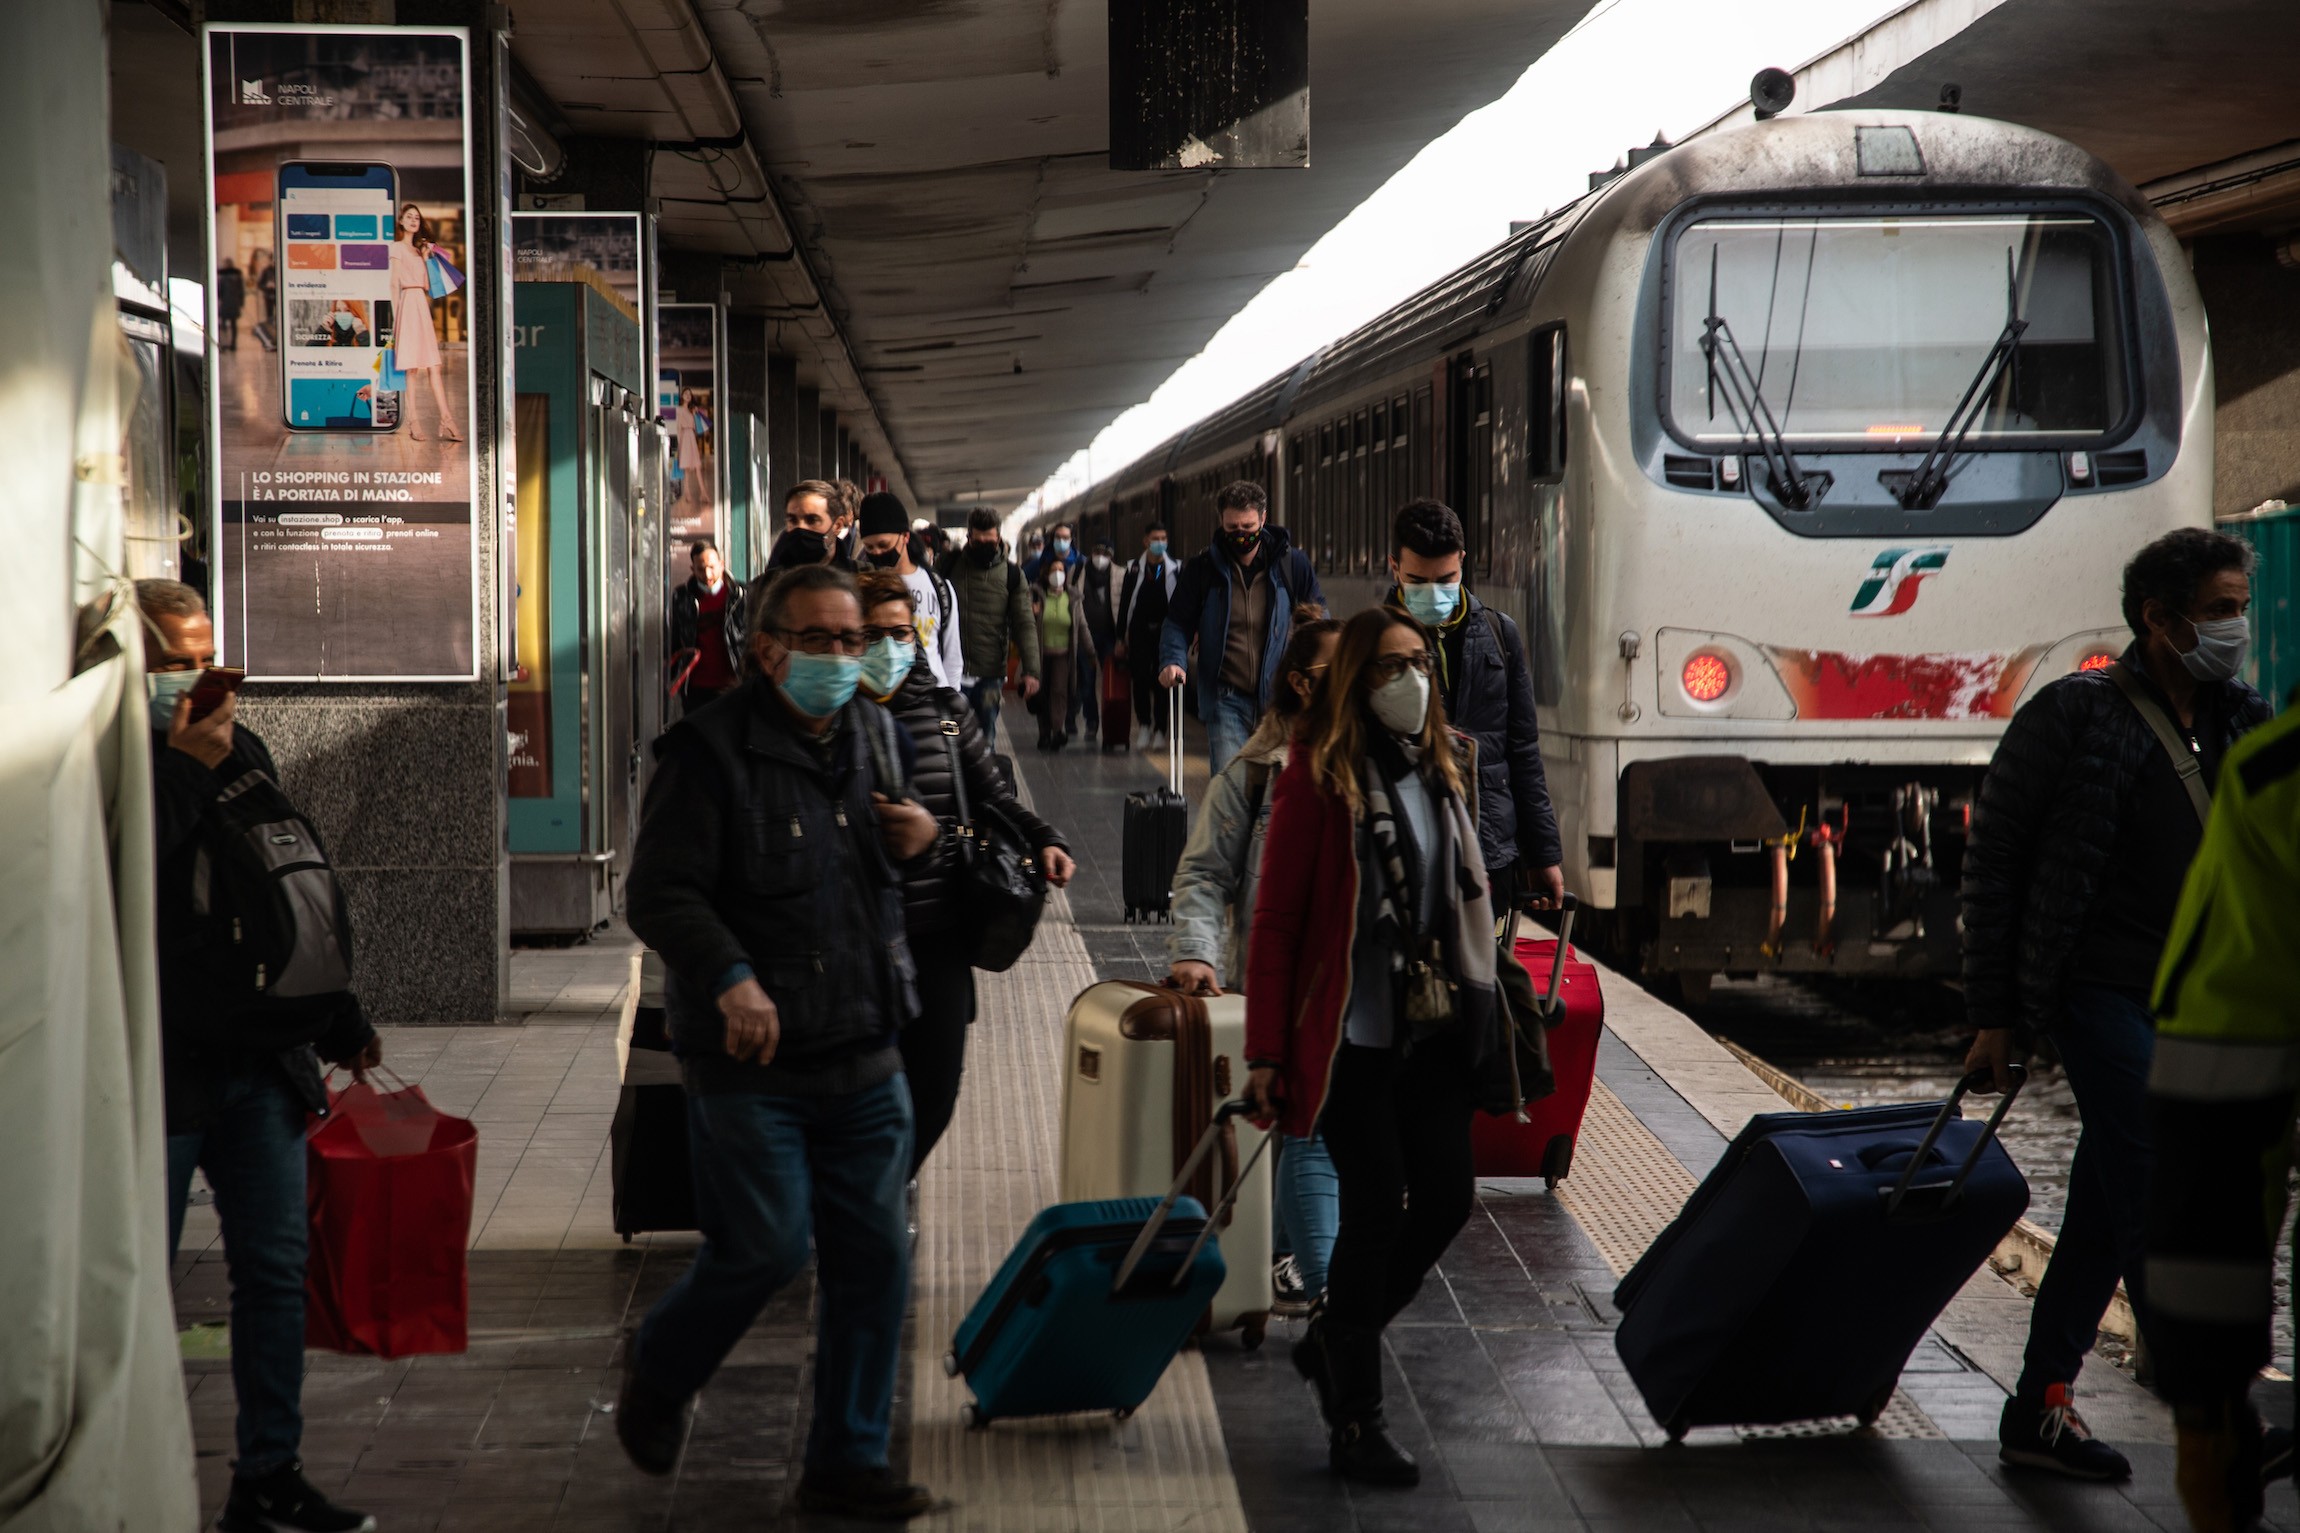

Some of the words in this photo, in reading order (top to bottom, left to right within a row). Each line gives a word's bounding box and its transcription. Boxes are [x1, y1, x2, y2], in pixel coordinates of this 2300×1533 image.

[277, 84, 317, 94] NAPOLI
[277, 95, 333, 106] CENTRALE
[517, 248, 543, 256] NAPOLI
[252, 471, 272, 484] LO
[275, 471, 350, 484] SHOPPING
[353, 471, 370, 484] IN
[373, 471, 442, 485] STAZIONE
[253, 485, 261, 501] È
[264, 489, 275, 501] A
[278, 489, 341, 501] PORTATA
[343, 489, 359, 501] DI
[362, 489, 413, 502] MANO.
[252, 515, 266, 523] Vai
[281, 514, 341, 525] instazione.shop
[352, 515, 380, 523] scarica
[276, 529, 284, 537] la
[286, 528, 319, 537] funzione
[324, 530, 354, 538] prenota
[386, 529, 414, 539] prenoti
[415, 528, 439, 537] online
[260, 543, 277, 551] ritiri
[278, 542, 320, 551] contactless
[321, 543, 329, 551] in
[330, 542, 353, 551] totale
[355, 542, 394, 551] sicurezza.
